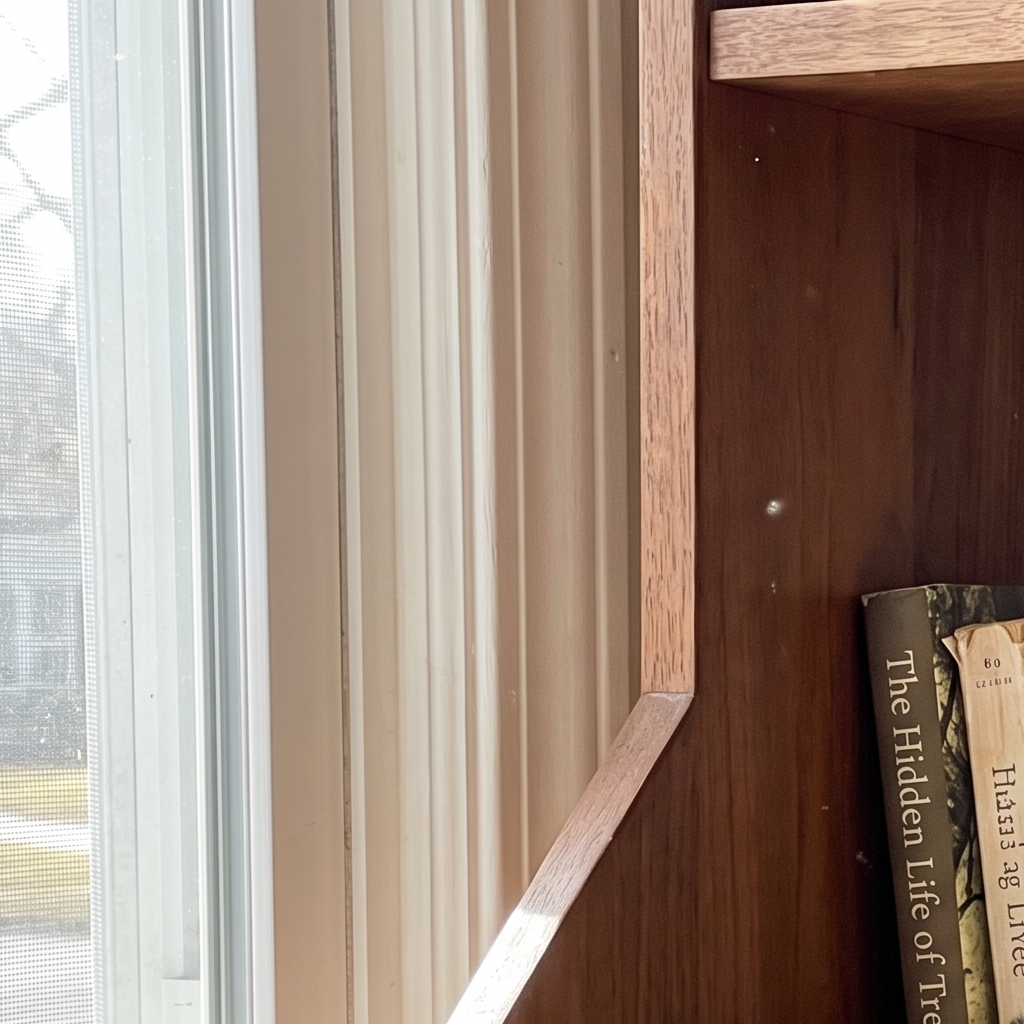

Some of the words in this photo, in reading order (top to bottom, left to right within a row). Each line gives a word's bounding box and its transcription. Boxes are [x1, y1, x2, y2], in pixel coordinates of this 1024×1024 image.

[885, 649, 919, 715] The
[892, 725, 931, 848] Hidden
[905, 857, 940, 920] Life
[914, 931, 945, 965] of
